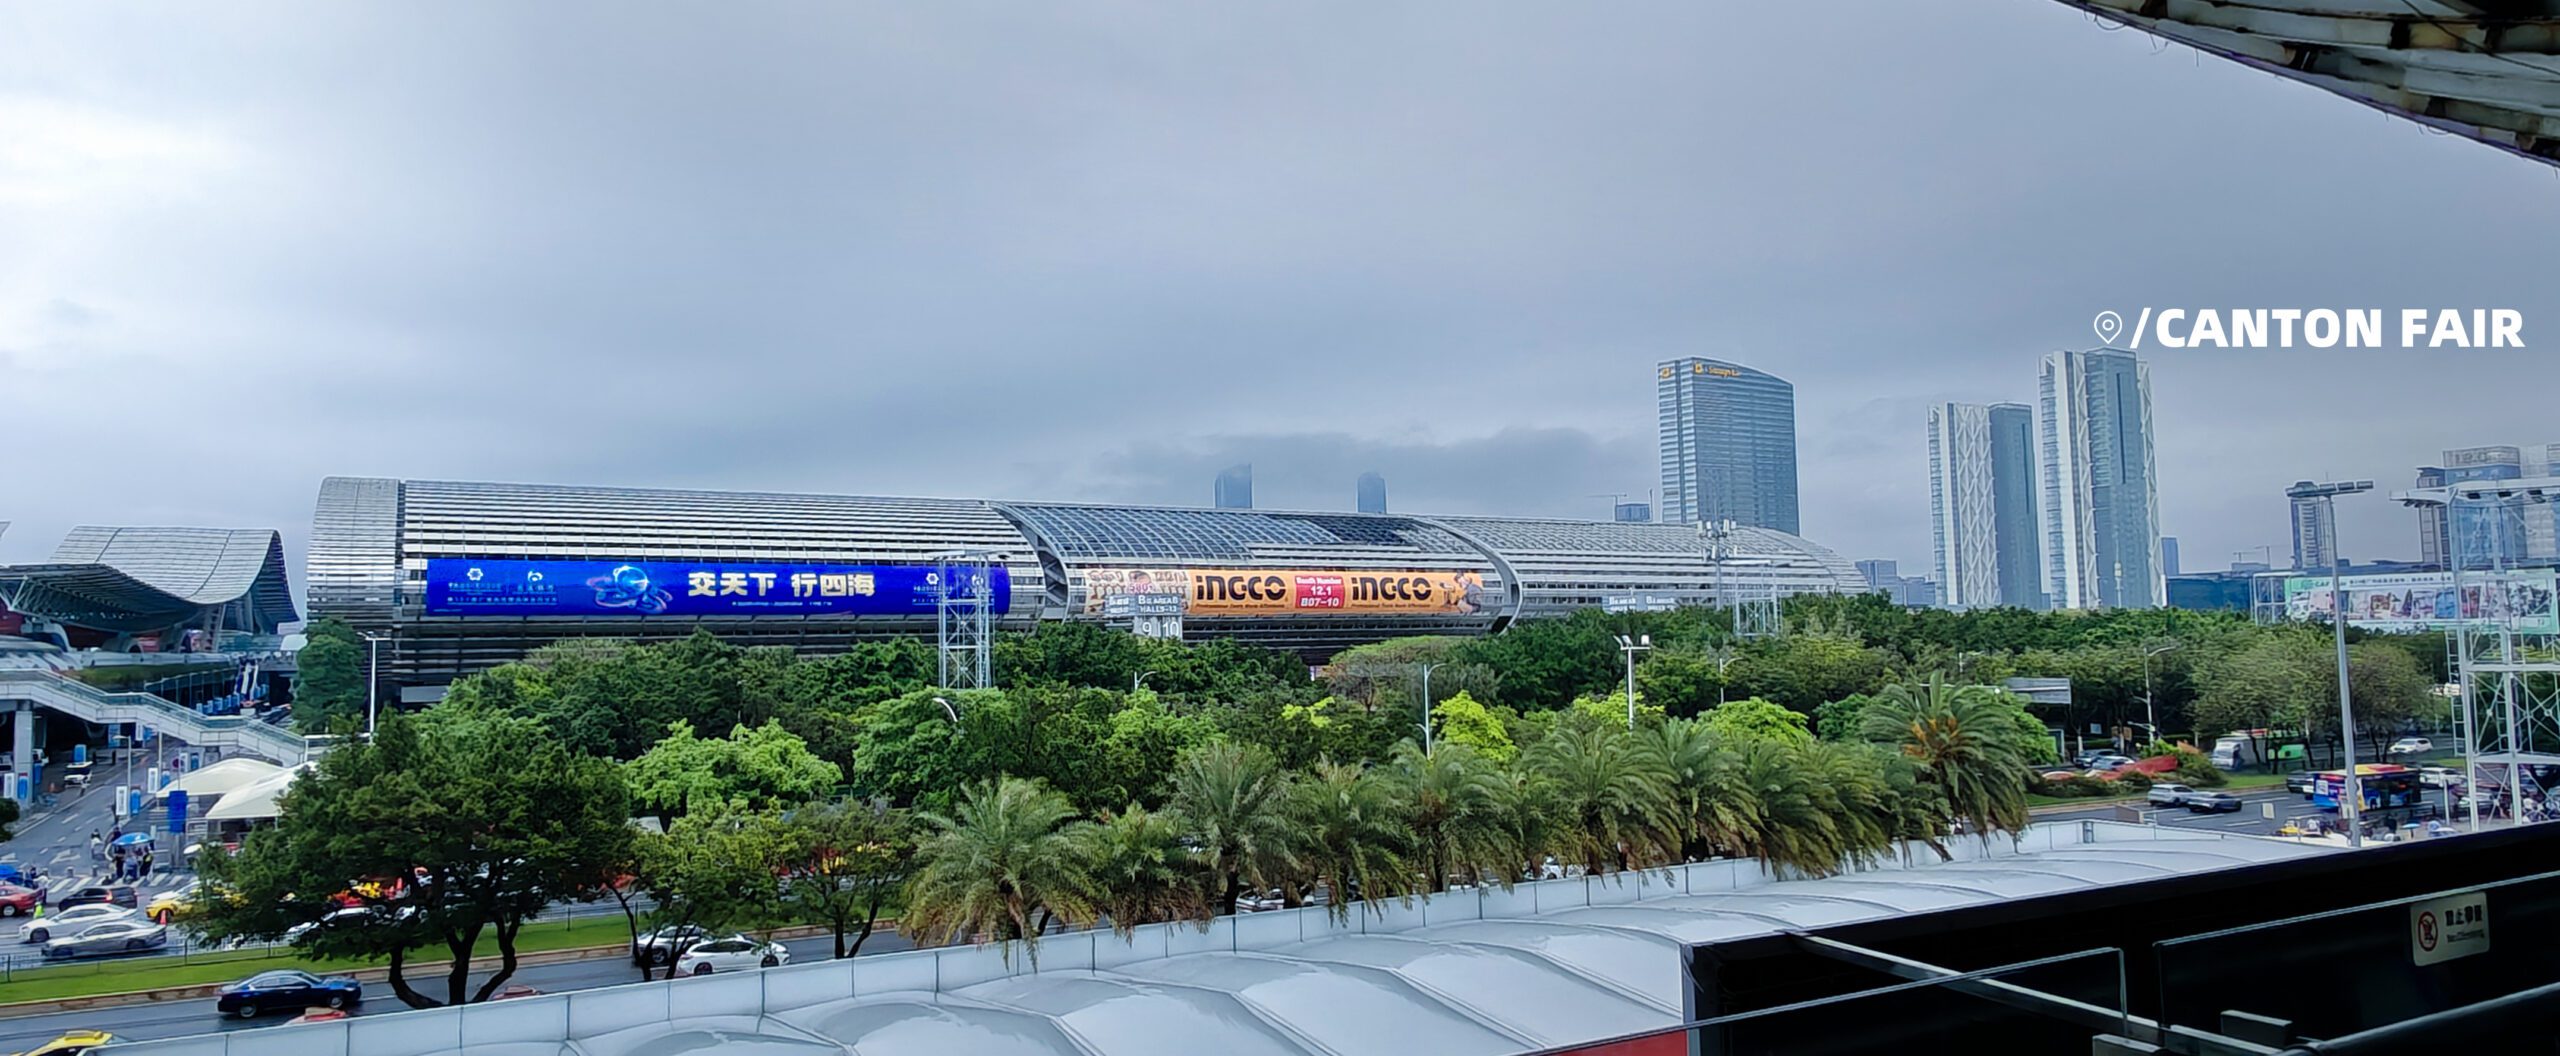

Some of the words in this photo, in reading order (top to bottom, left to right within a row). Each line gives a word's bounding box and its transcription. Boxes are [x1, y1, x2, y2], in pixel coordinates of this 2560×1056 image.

[688, 571, 777, 597] 交天下
[791, 572, 875, 597] 行四海
[1310, 585, 1332, 596] 12.1
[1142, 621, 1152, 636] 9
[1162, 620, 1179, 637] 10
